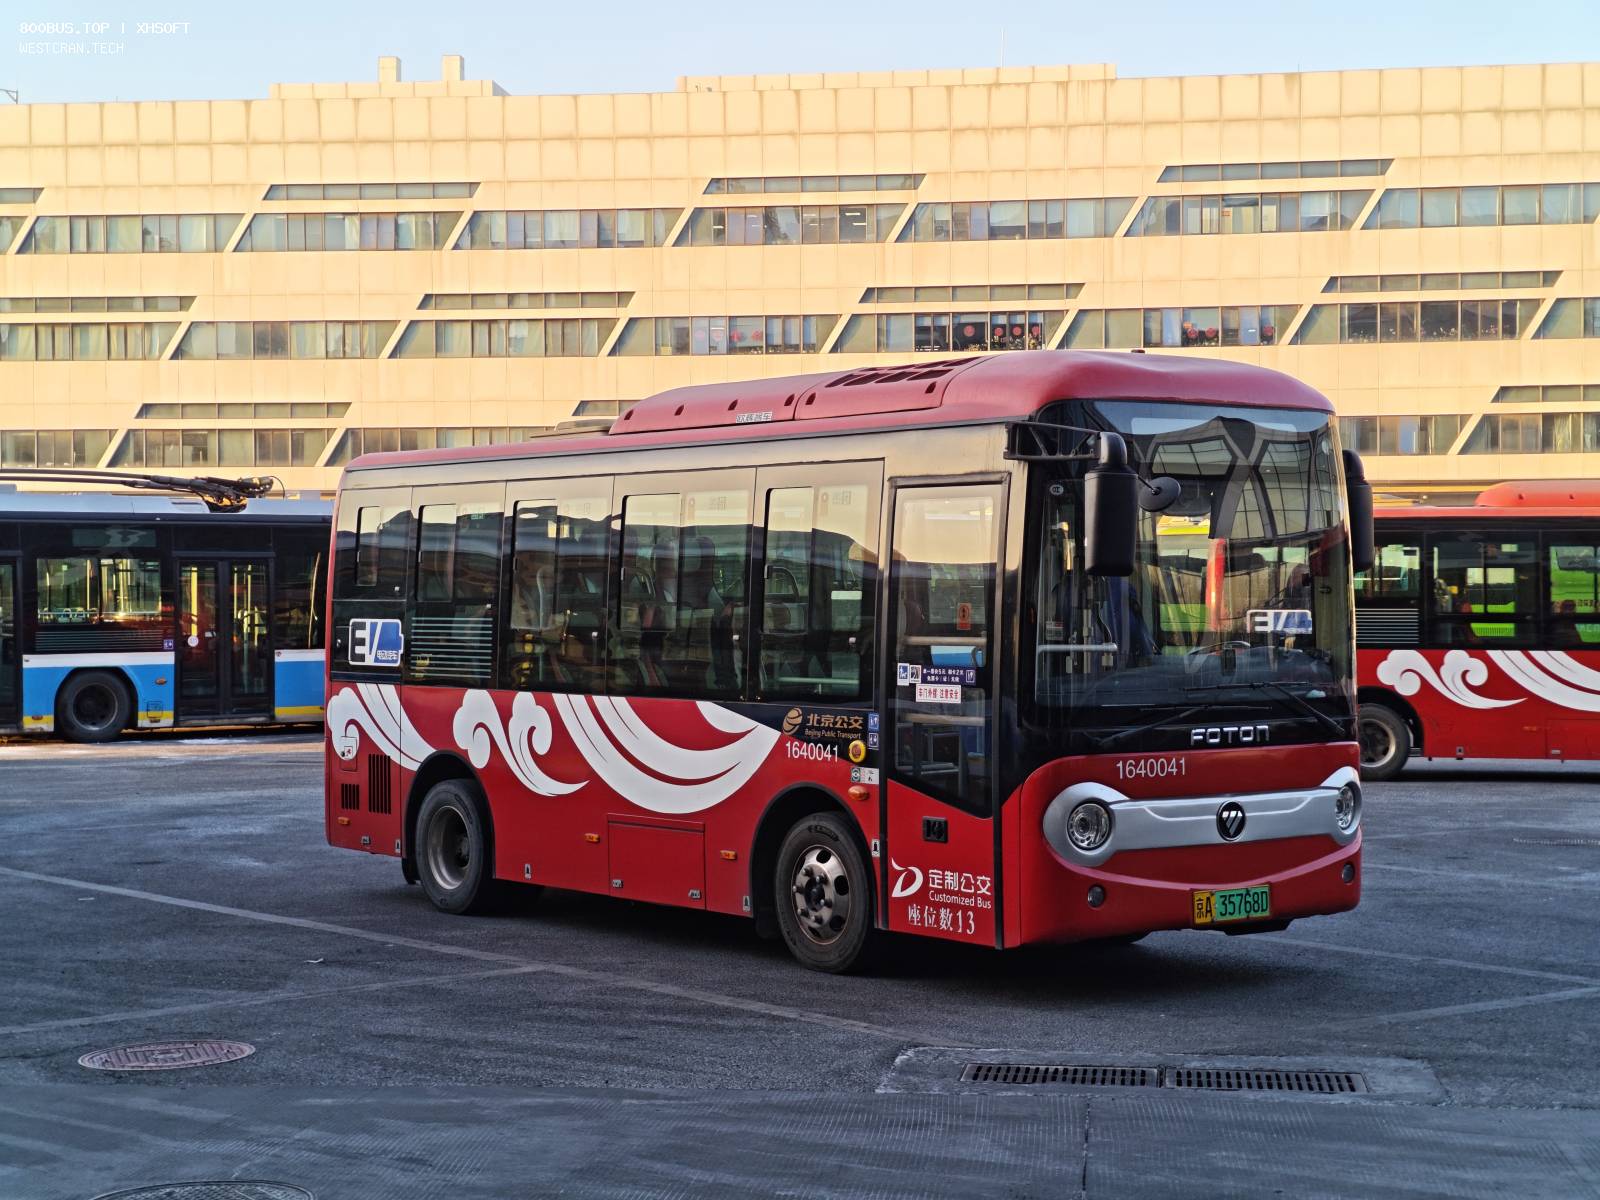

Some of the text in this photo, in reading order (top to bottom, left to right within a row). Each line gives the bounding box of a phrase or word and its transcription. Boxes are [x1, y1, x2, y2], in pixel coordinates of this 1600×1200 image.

[806, 713, 864, 730] 北京公交
[805, 728, 861, 740] Beijing Public Transport
[1190, 725, 1270, 746] FOTON
[785, 740, 838, 763] 1640041
[1116, 757, 1186, 780] 1640041
[928, 869, 992, 896] 定制公交
[928, 890, 992, 909] Customized Bus
[908, 903, 975, 935] 座位数13
